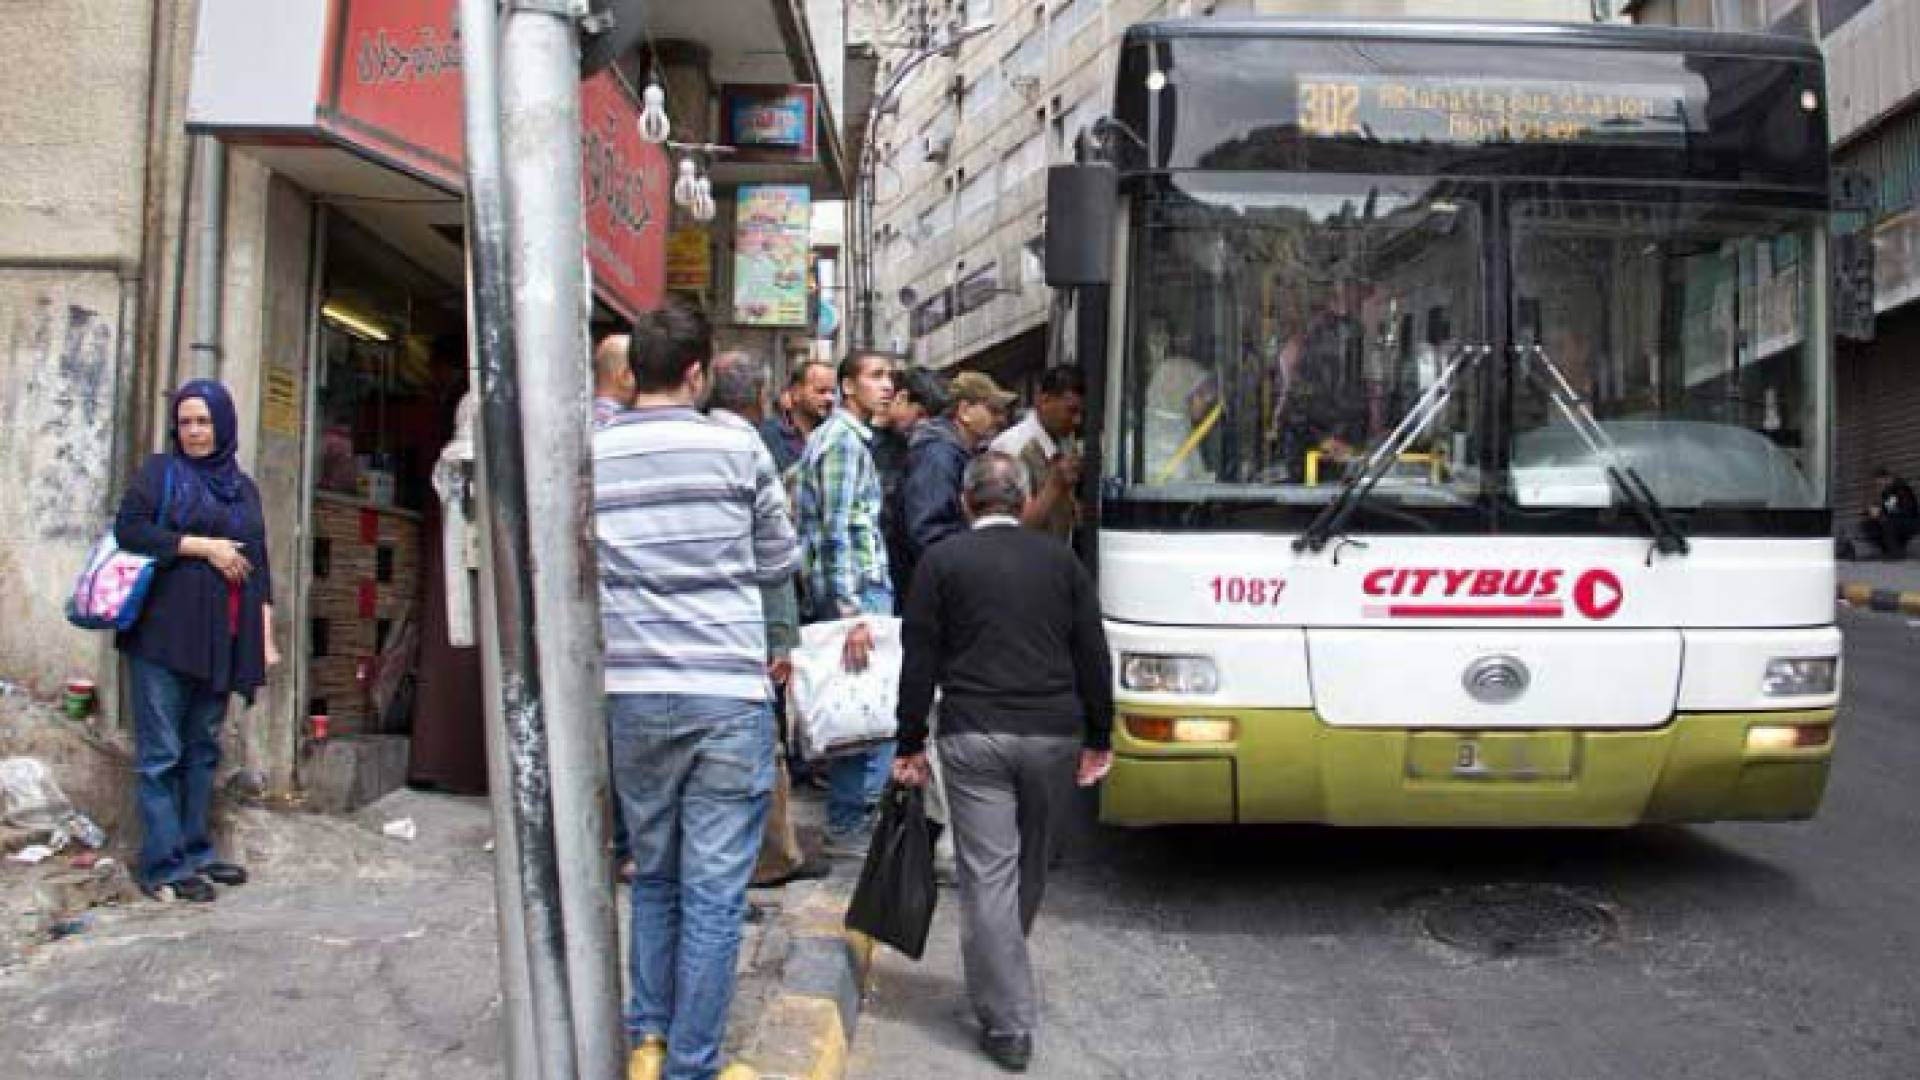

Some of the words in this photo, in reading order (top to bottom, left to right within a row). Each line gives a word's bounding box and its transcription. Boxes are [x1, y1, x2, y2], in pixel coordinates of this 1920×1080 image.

[1297, 82, 1361, 136] 302
[1209, 577, 1286, 605] 1087
[1362, 568, 1564, 597] CITYBUS
